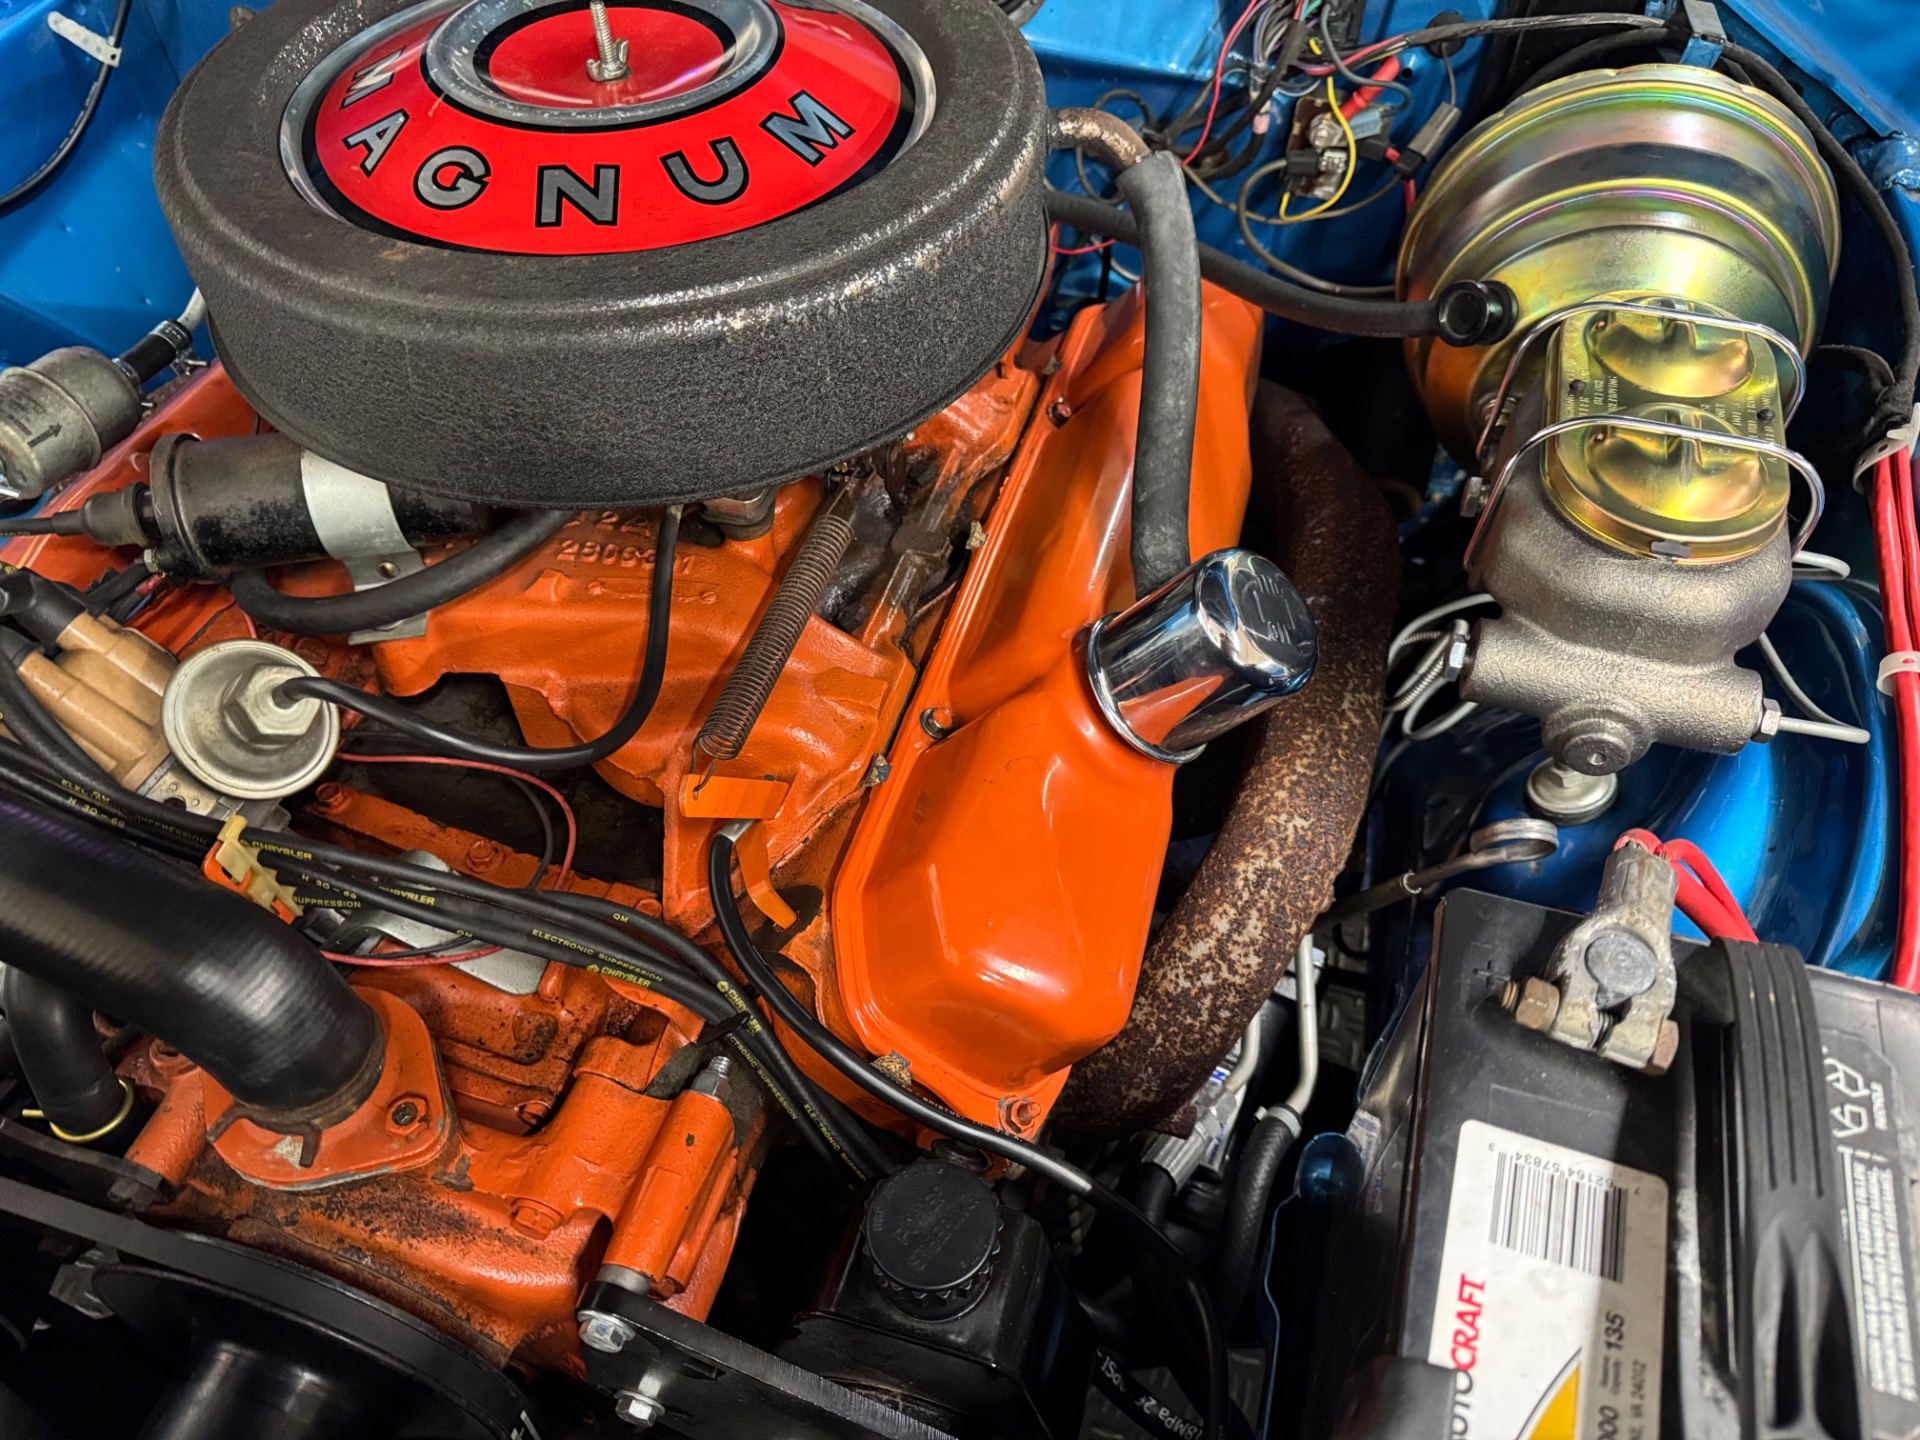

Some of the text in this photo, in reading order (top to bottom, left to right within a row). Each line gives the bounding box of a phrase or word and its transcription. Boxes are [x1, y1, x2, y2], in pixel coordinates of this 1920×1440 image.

[340, 48, 856, 227] MAGNUM
[252, 841, 313, 860] CHRYSLER
[532, 929, 663, 982] ELECTRONIC SUPPRESSION
[601, 966, 652, 988] CHRYSLER
[756, 1069, 798, 1120] SUPPRESSION
[803, 1103, 841, 1151] ELECTRONIC
[1515, 1151, 1561, 1175] 57834
[1567, 1169, 1615, 1190] 62164
[1604, 1310, 1626, 1351] 135
